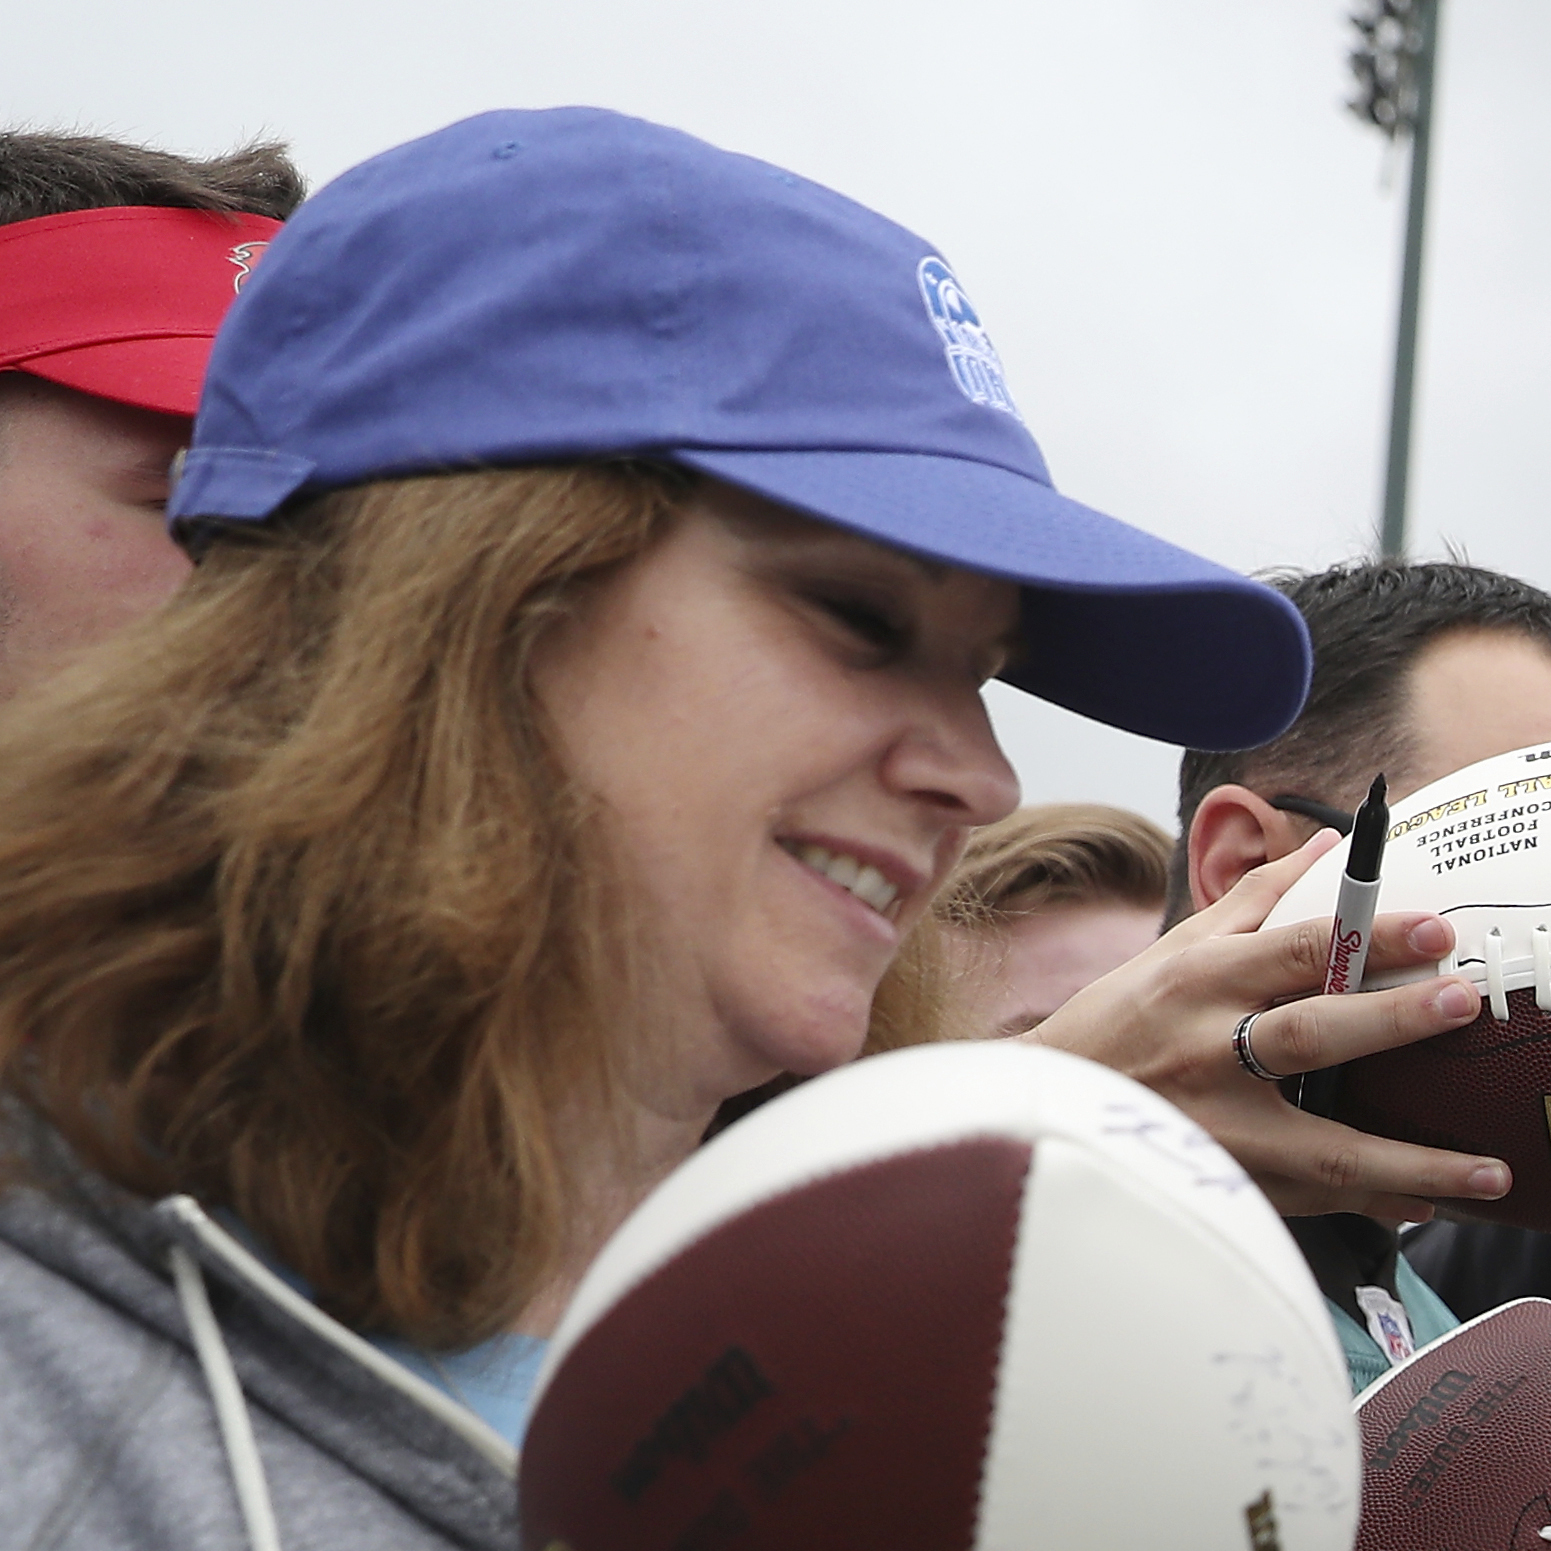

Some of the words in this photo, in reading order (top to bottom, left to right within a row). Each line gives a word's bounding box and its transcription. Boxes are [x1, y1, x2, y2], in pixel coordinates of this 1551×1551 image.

[1387, 789, 1488, 842] LEAGU
[1430, 819, 1538, 857] FOOTBALL
[1432, 836, 1538, 875] NATIONAL
[1328, 918, 1362, 994] Sharpie
